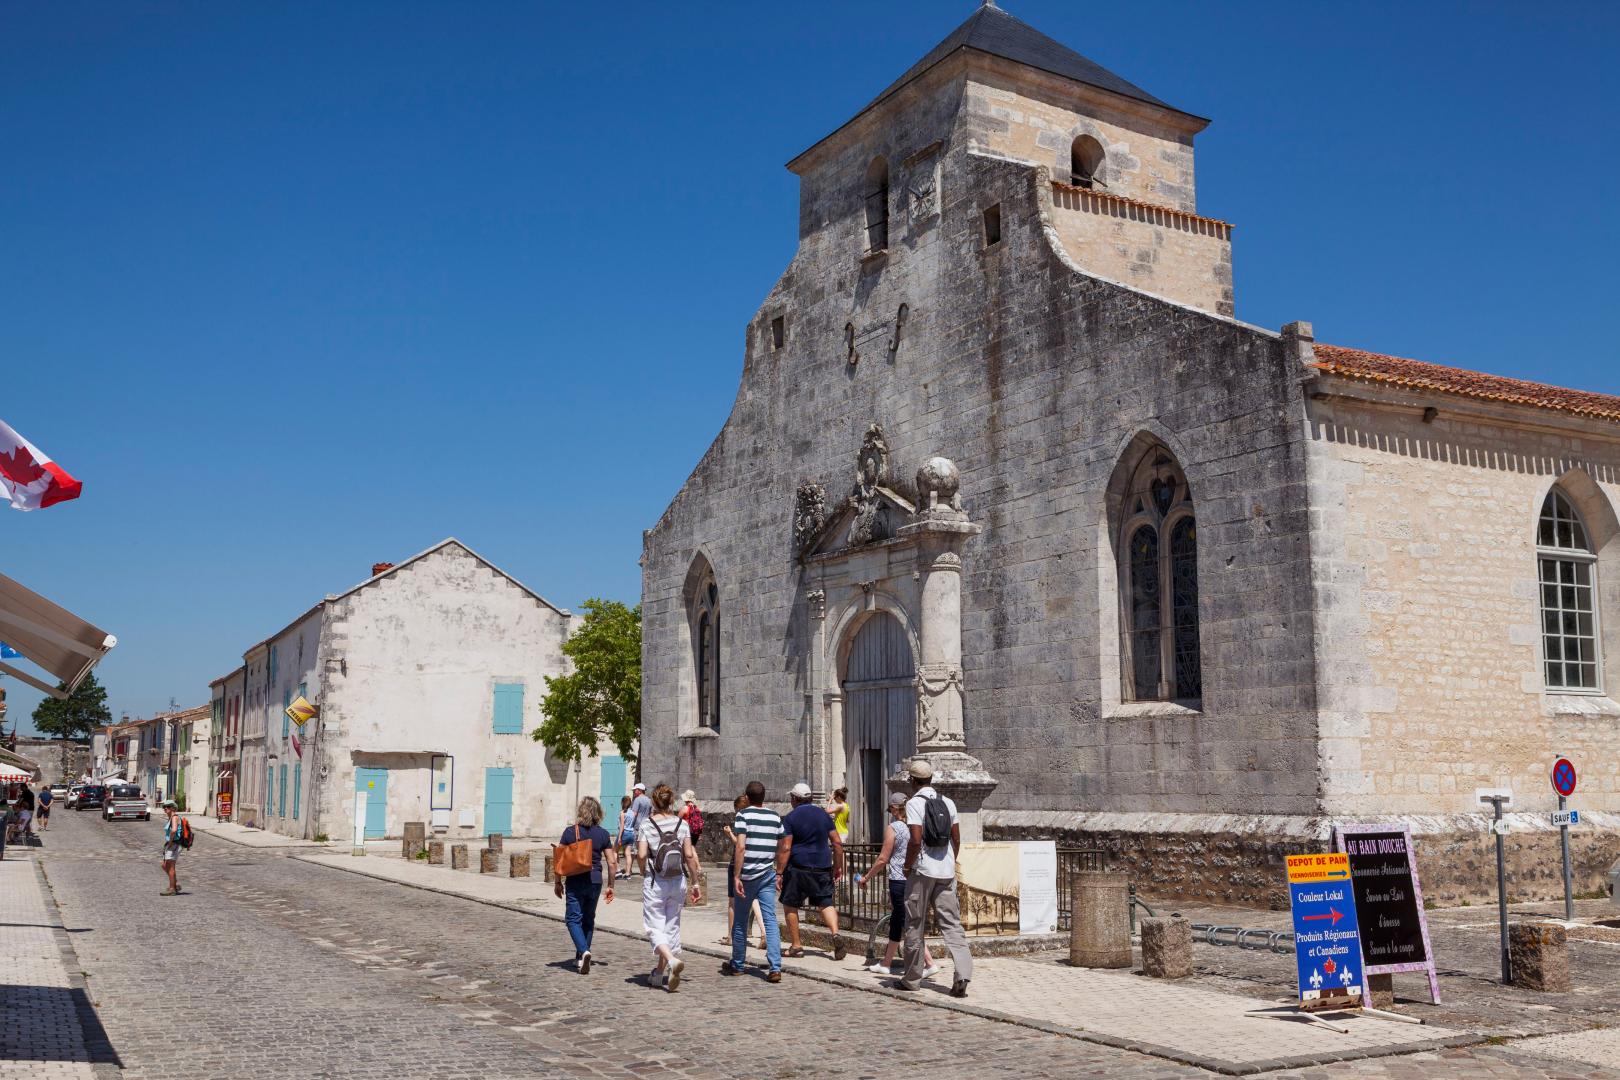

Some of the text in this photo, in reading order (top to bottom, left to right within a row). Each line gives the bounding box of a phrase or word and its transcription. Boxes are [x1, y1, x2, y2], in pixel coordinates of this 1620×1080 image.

[288, 708, 303, 724] PRESSE
[1554, 813, 1570, 823] SAUF
[1348, 838, 1406, 855] AU BAIN DOUCHE
[1288, 856, 1347, 867] DEPOT DE PAIN
[1290, 871, 1326, 879] VIENNOISERIES
[1298, 890, 1343, 903] Couleur Lokal
[1296, 930, 1357, 943] Produits Régionaux
[1308, 945, 1349, 957] et Canadiens
[1370, 940, 1386, 955] Savon
[1391, 939, 1398, 953] la
